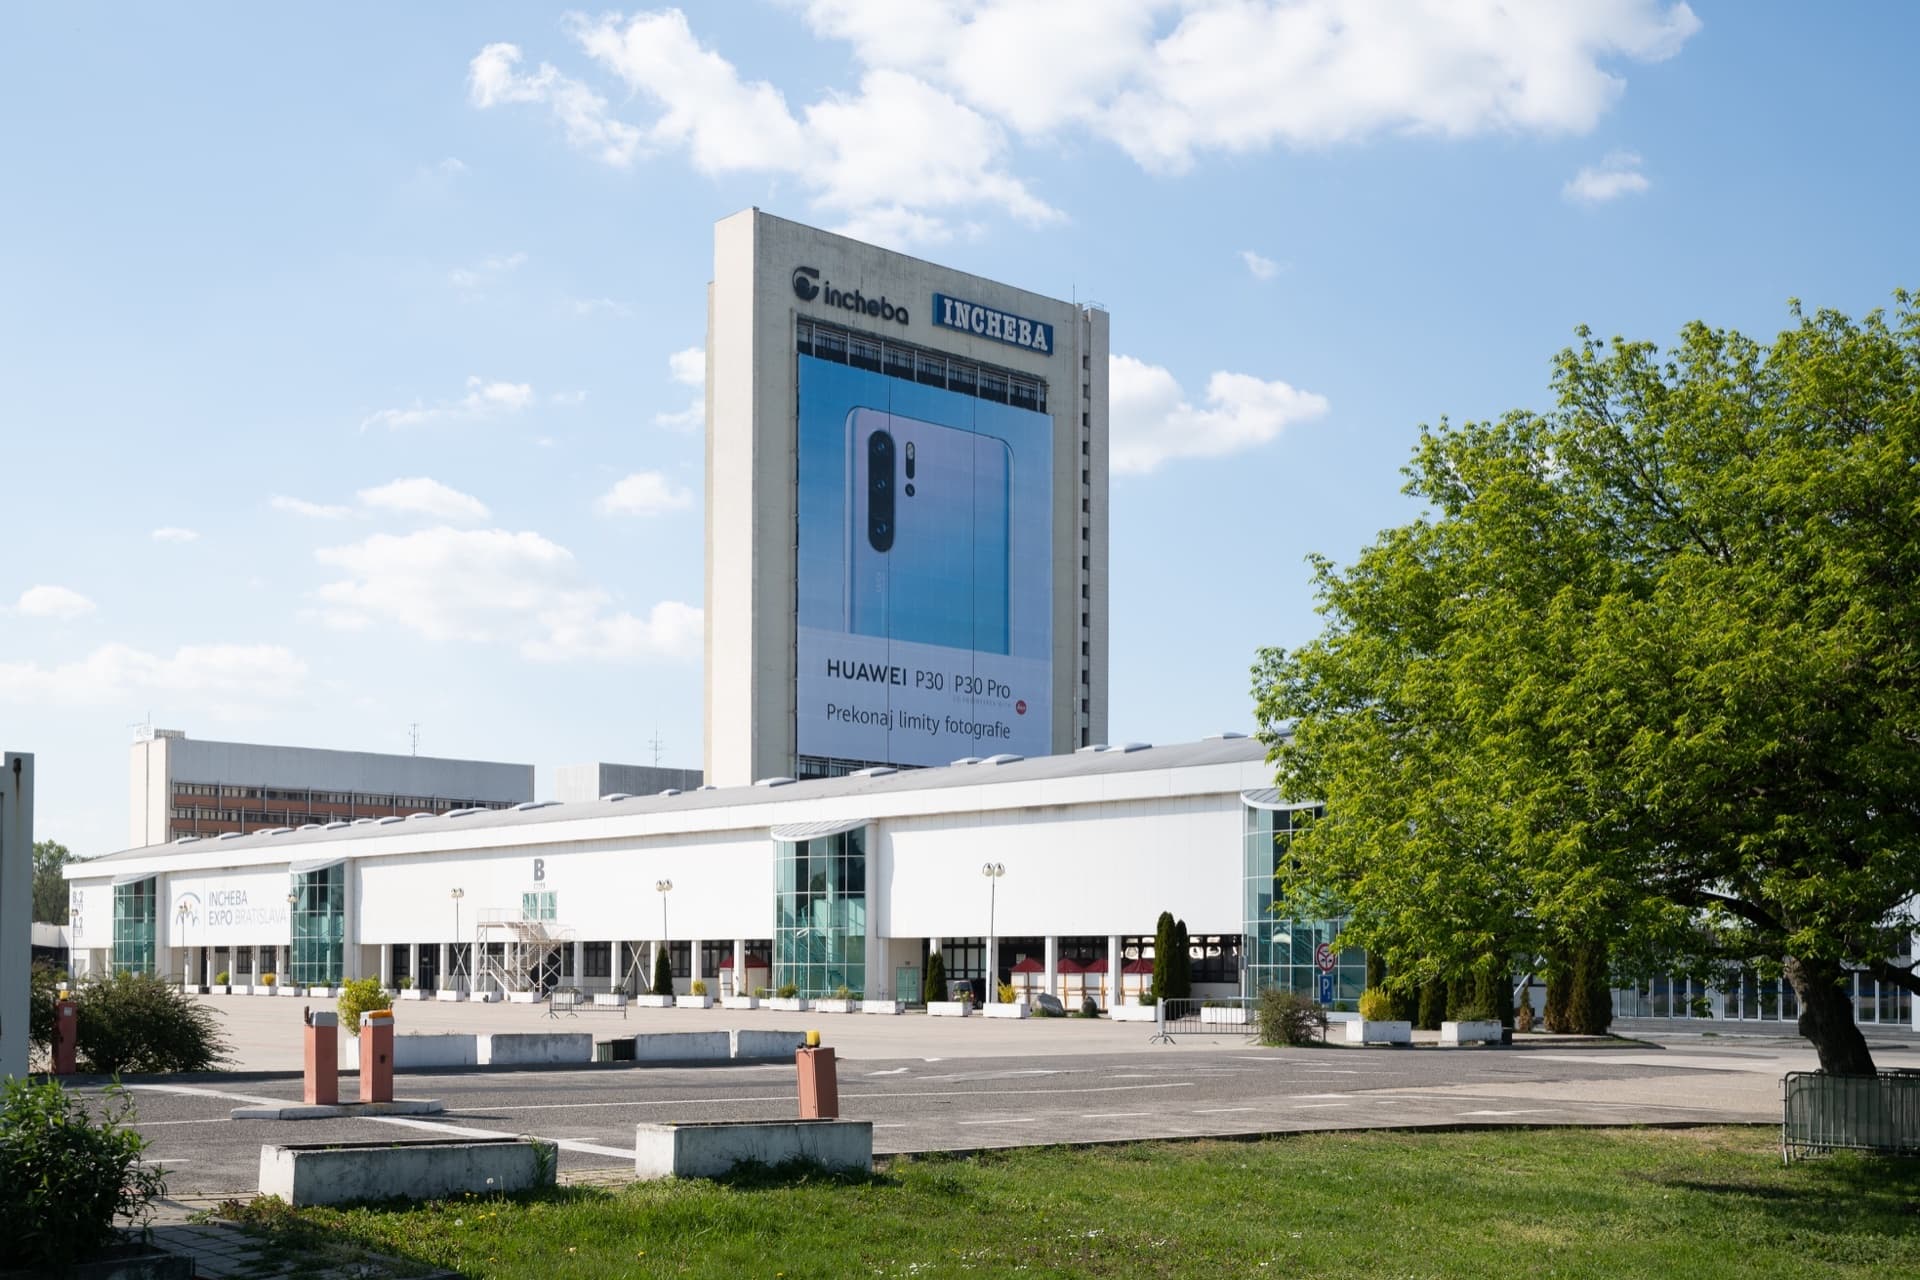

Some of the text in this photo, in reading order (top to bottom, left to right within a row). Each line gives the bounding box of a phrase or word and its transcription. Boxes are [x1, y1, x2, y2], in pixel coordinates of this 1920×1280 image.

[824, 281, 909, 326] incheba
[943, 298, 1048, 351] INCHEBA
[827, 659, 1011, 699] HUAWEI P30 P30 Pro
[827, 703, 1011, 740] Prekonaj limity fotografie
[534, 859, 545, 881] B
[208, 890, 248, 906] INCHEBA
[208, 909, 233, 926] EXPO
